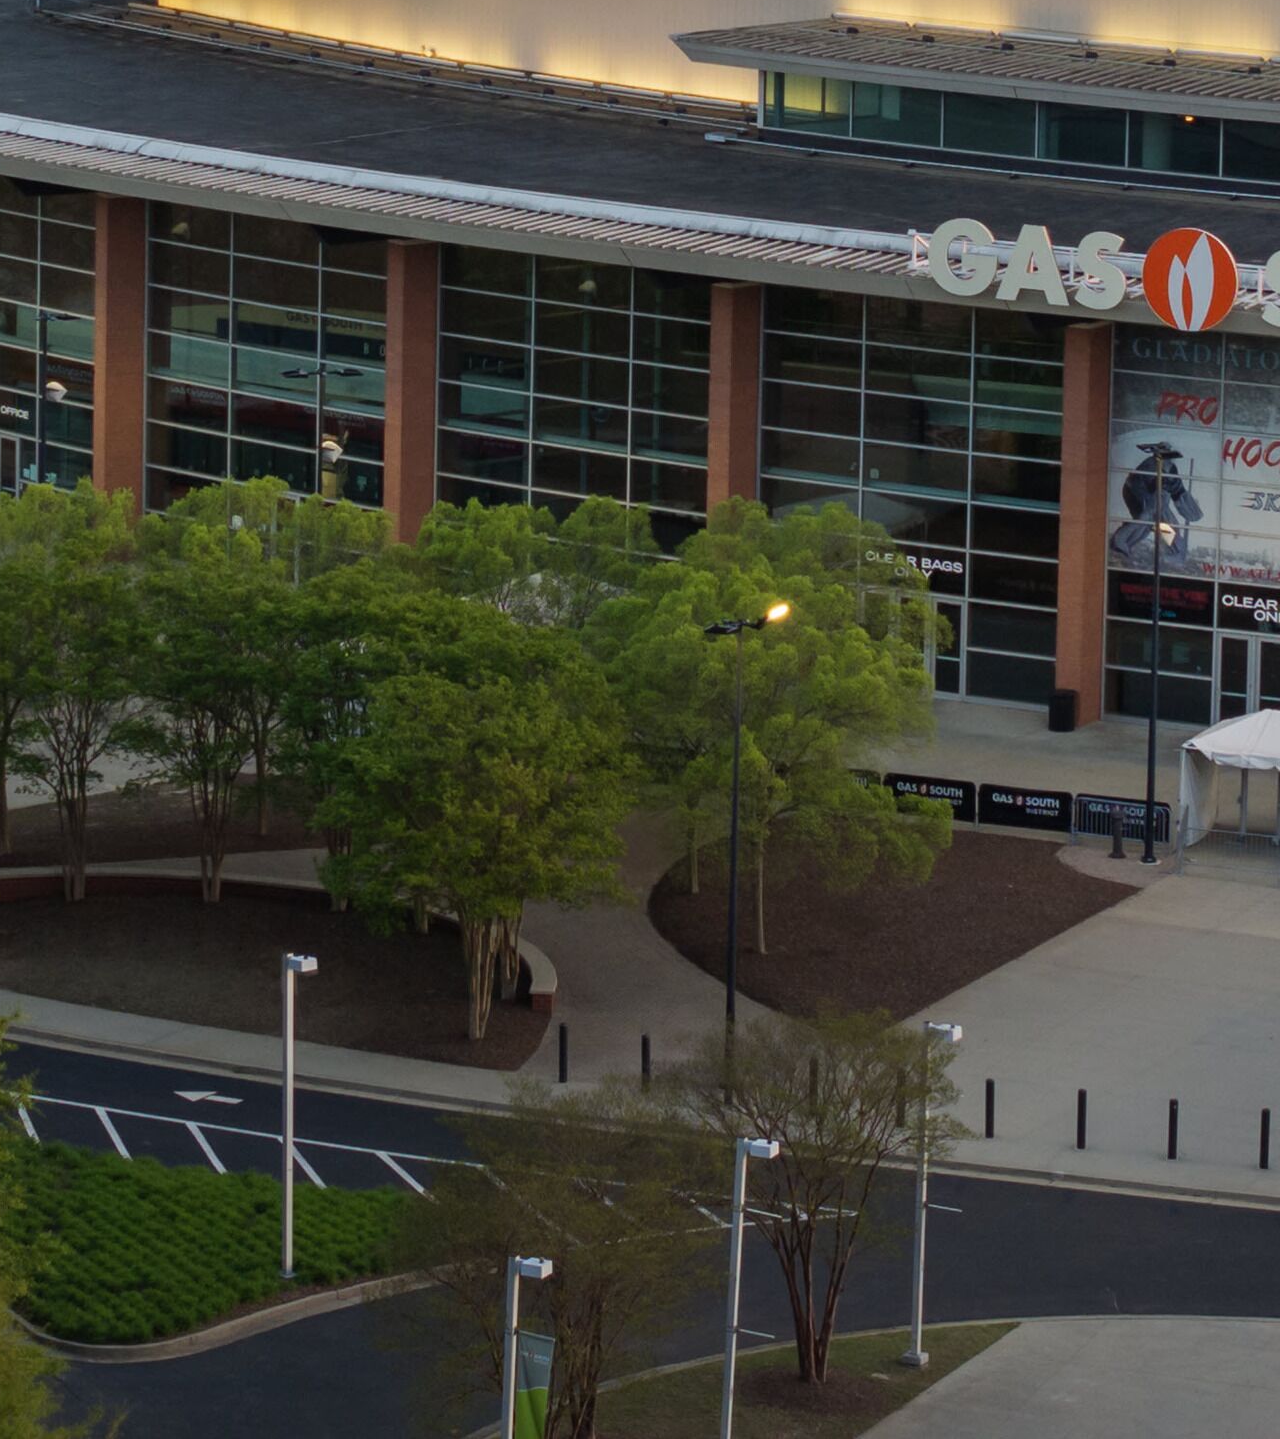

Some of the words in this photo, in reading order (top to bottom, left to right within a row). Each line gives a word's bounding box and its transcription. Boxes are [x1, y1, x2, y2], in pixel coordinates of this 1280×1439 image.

[927, 217, 1127, 309] GAS
[0, 405, 30, 420] OFFICE
[1154, 391, 1218, 426] PRO
[921, 557, 964, 574] BAGS
[1221, 594, 1279, 611] CLEAR
[896, 781, 919, 793] GAS
[929, 785, 964, 799] SOUTH
[992, 792, 1014, 804] GAS
[1024, 796, 1060, 809] SOUTH
[1088, 802, 1111, 813] GAS
